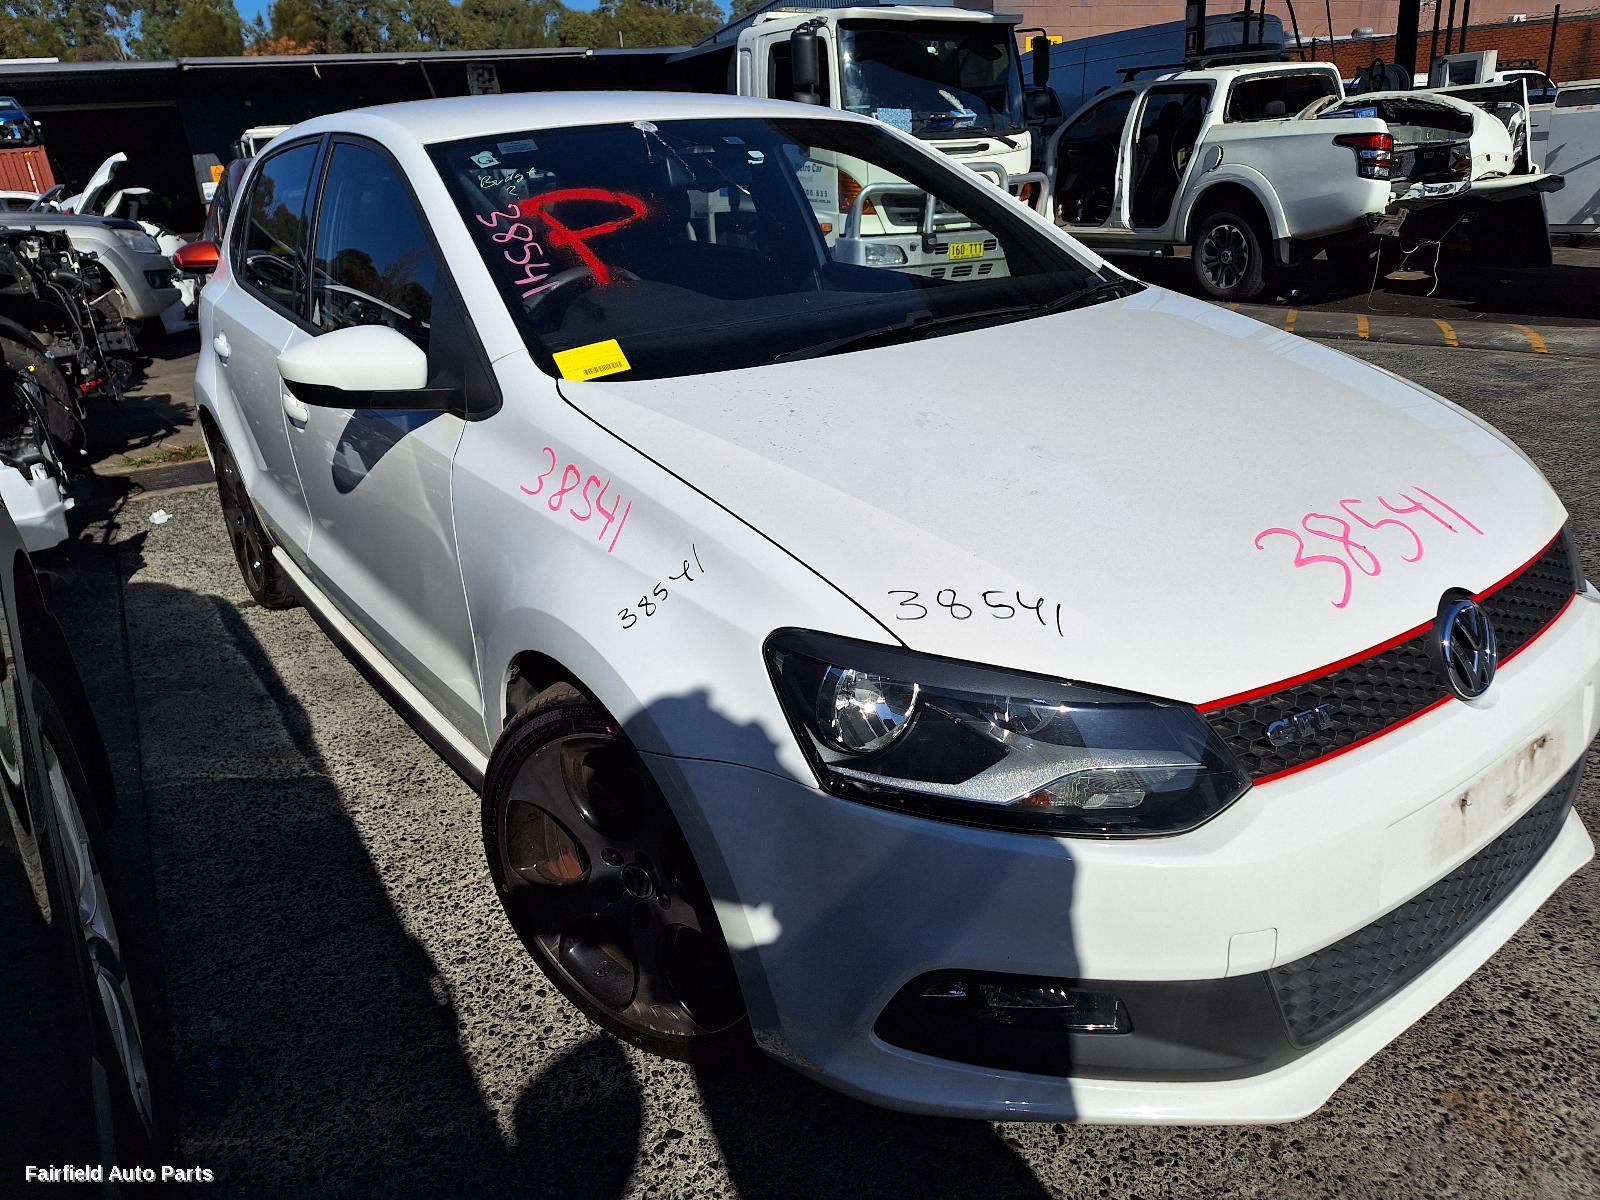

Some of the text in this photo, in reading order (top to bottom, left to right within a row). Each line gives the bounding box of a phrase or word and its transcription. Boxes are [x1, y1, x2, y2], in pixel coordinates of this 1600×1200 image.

[812, 164, 822, 172] Car
[476, 203, 560, 300] 38541
[519, 446, 633, 553] 38541
[617, 544, 704, 630] 38541
[1254, 485, 1485, 609] 38541
[887, 589, 1064, 637] 38541
